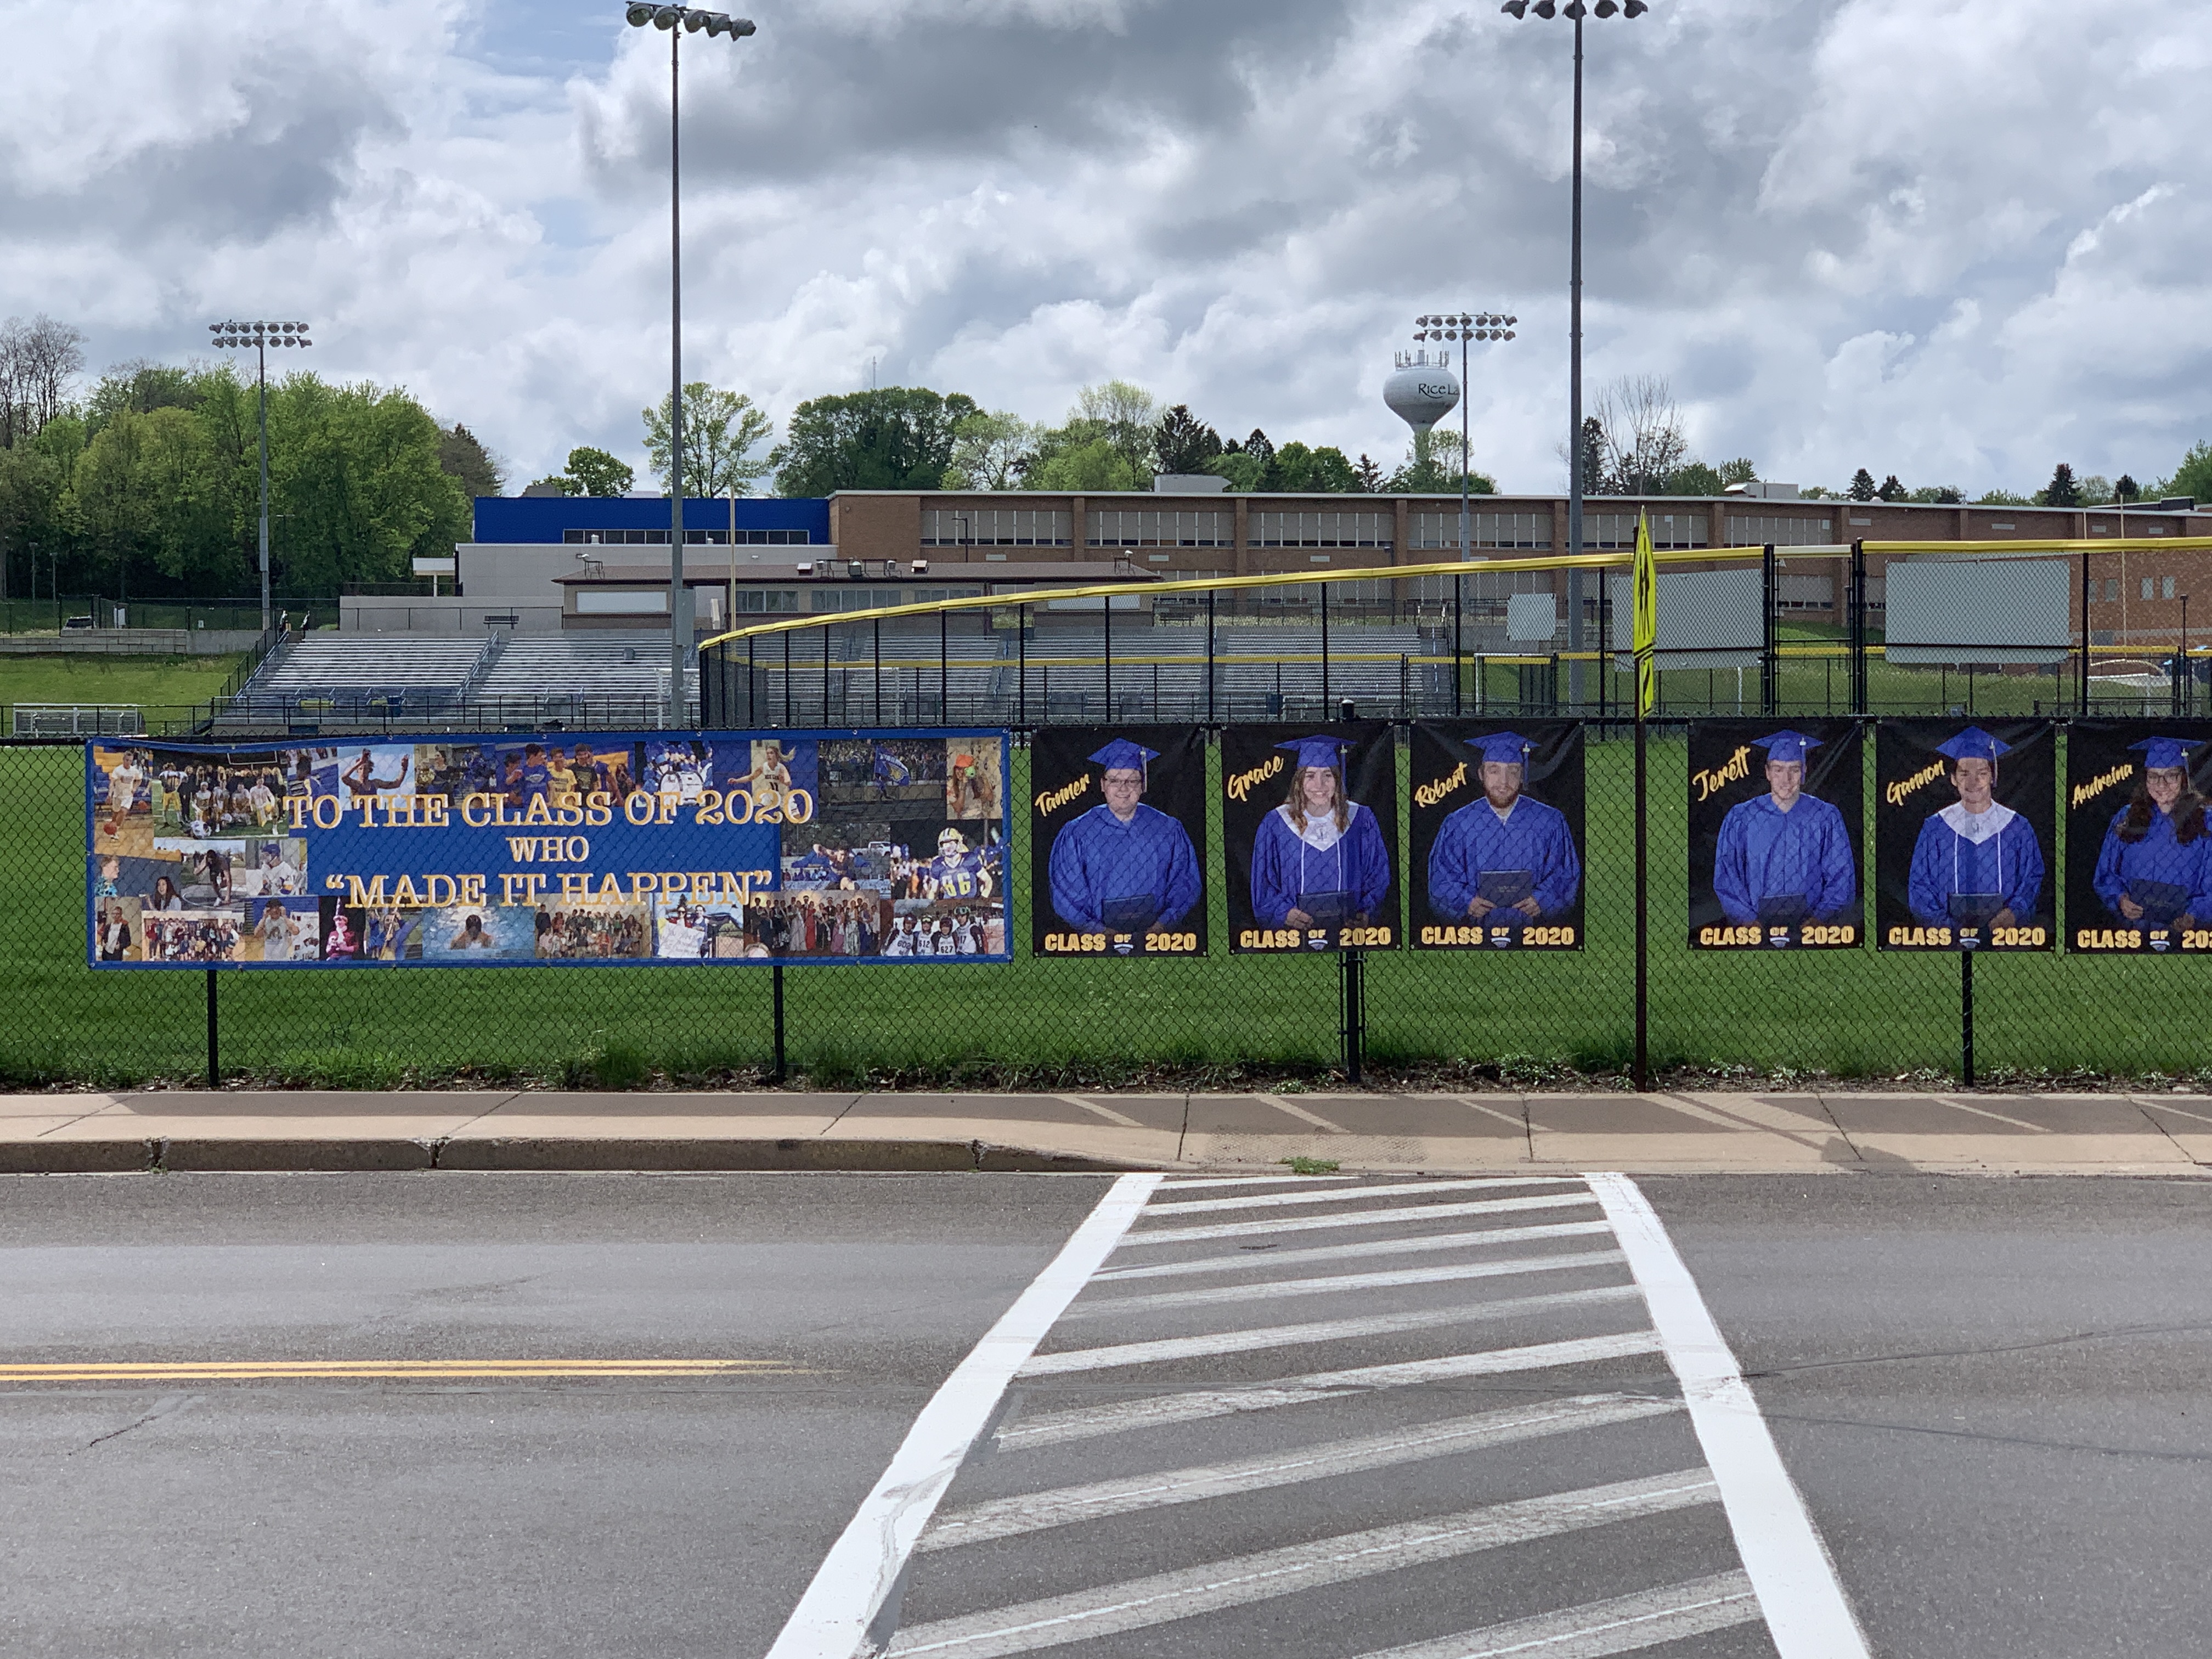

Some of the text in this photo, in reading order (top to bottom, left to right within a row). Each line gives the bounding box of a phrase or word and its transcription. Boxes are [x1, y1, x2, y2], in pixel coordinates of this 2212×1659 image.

[1228, 755, 1284, 802] Grace
[1414, 762, 1468, 808] Robert
[1692, 746, 1751, 802] Jerett
[1887, 760, 1945, 806] Gannon
[2072, 764, 2134, 809] Andreina
[283, 789, 813, 829] TO THE CLASS OF 2020
[1035, 774, 1090, 817] Tanner
[506, 836, 589, 863] WHO
[499, 873, 546, 907] IT
[1046, 933, 1197, 952] CLASS OF 2020
[1241, 928, 1391, 948] CLASS OF 2020
[1423, 927, 1483, 945] CLASS
[1523, 927, 1575, 945] 2020
[1701, 927, 1854, 945] CLASS OF 2020
[1889, 928, 2045, 946] CLASS OF 2020
[2078, 930, 2212, 949] CLASS OF 20
